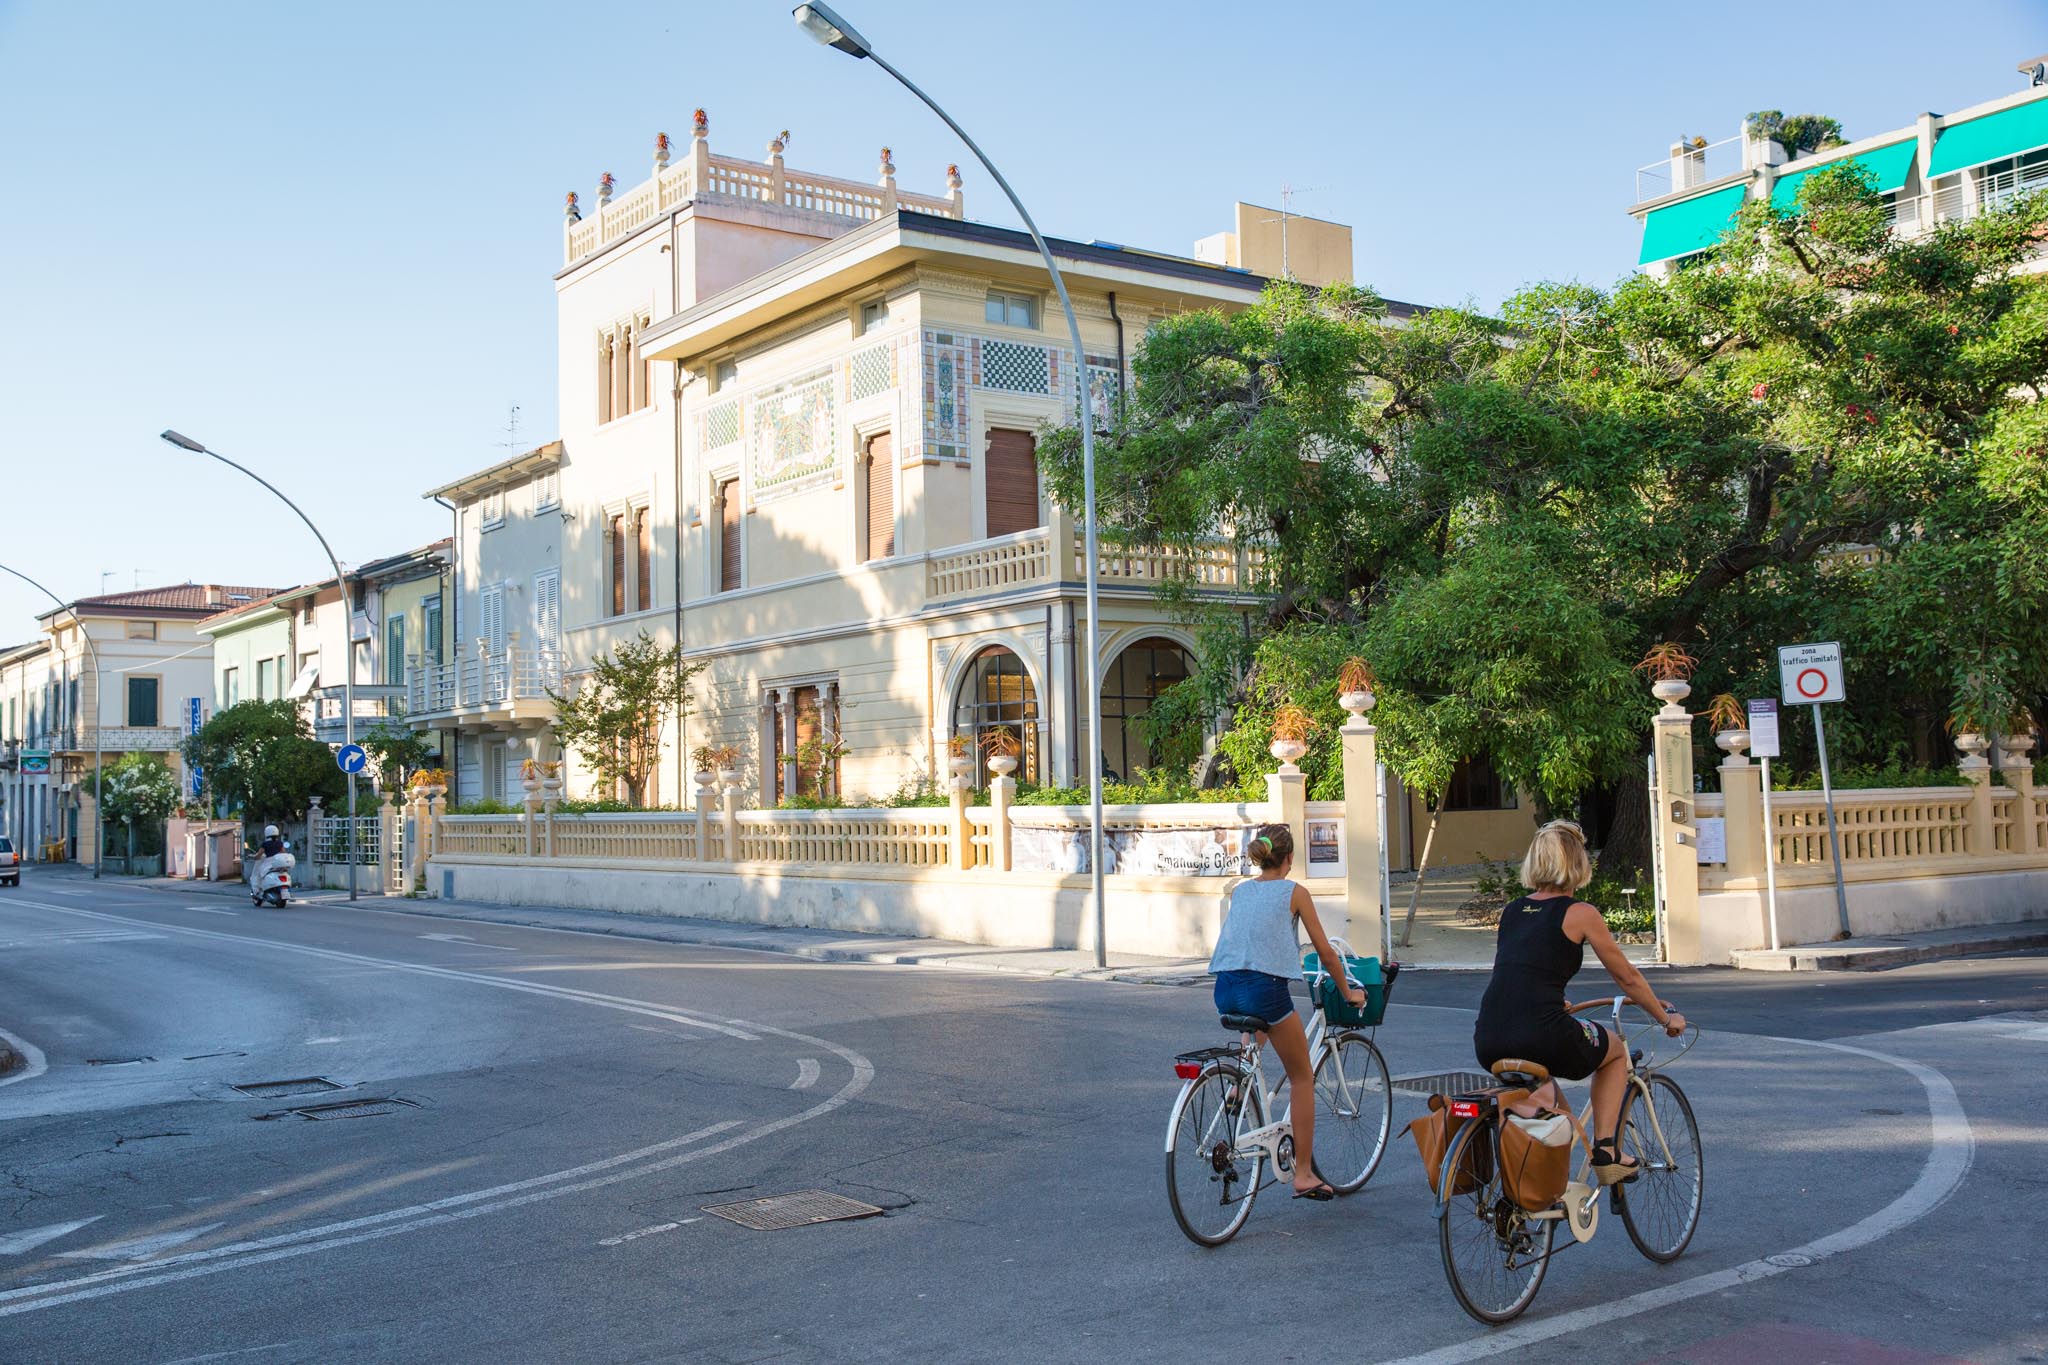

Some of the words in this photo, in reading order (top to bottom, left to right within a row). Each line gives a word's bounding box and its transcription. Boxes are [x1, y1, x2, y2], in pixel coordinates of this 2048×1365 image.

[1782, 656, 1809, 666] traffico
[1811, 654, 1838, 663] limitato
[1157, 852, 1210, 869] Emanuele
